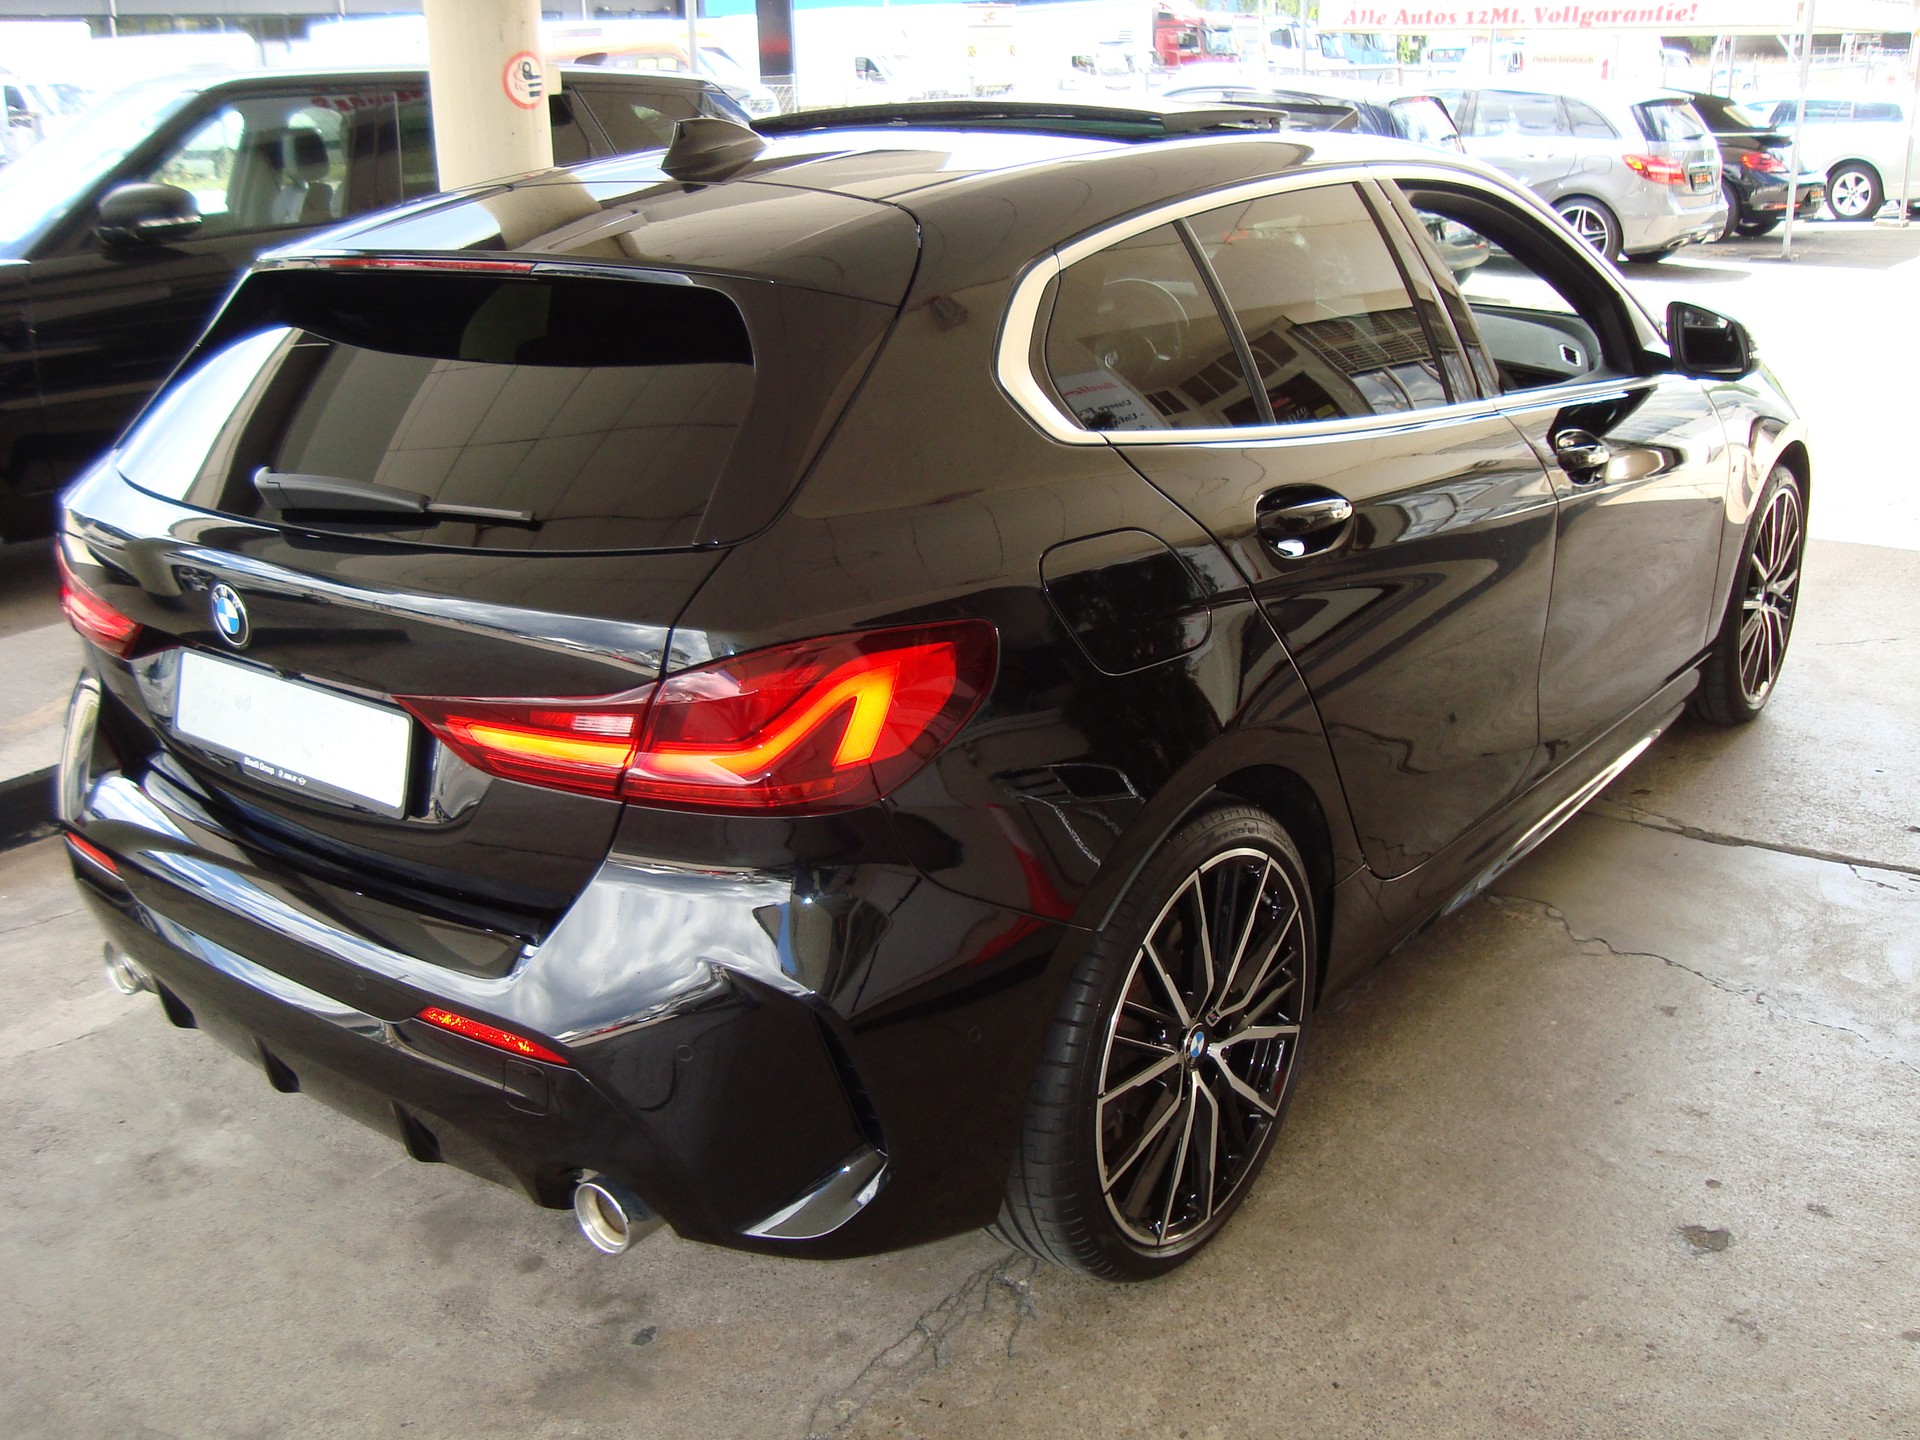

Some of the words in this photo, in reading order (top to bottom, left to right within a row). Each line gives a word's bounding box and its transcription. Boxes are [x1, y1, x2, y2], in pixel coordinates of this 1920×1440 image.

[1342, 9, 1388, 25] Alle
[1393, 8, 1459, 25] Autos
[1465, 7, 1526, 25] 12Mt.
[1534, 2, 1698, 28] Vollgarantie!
